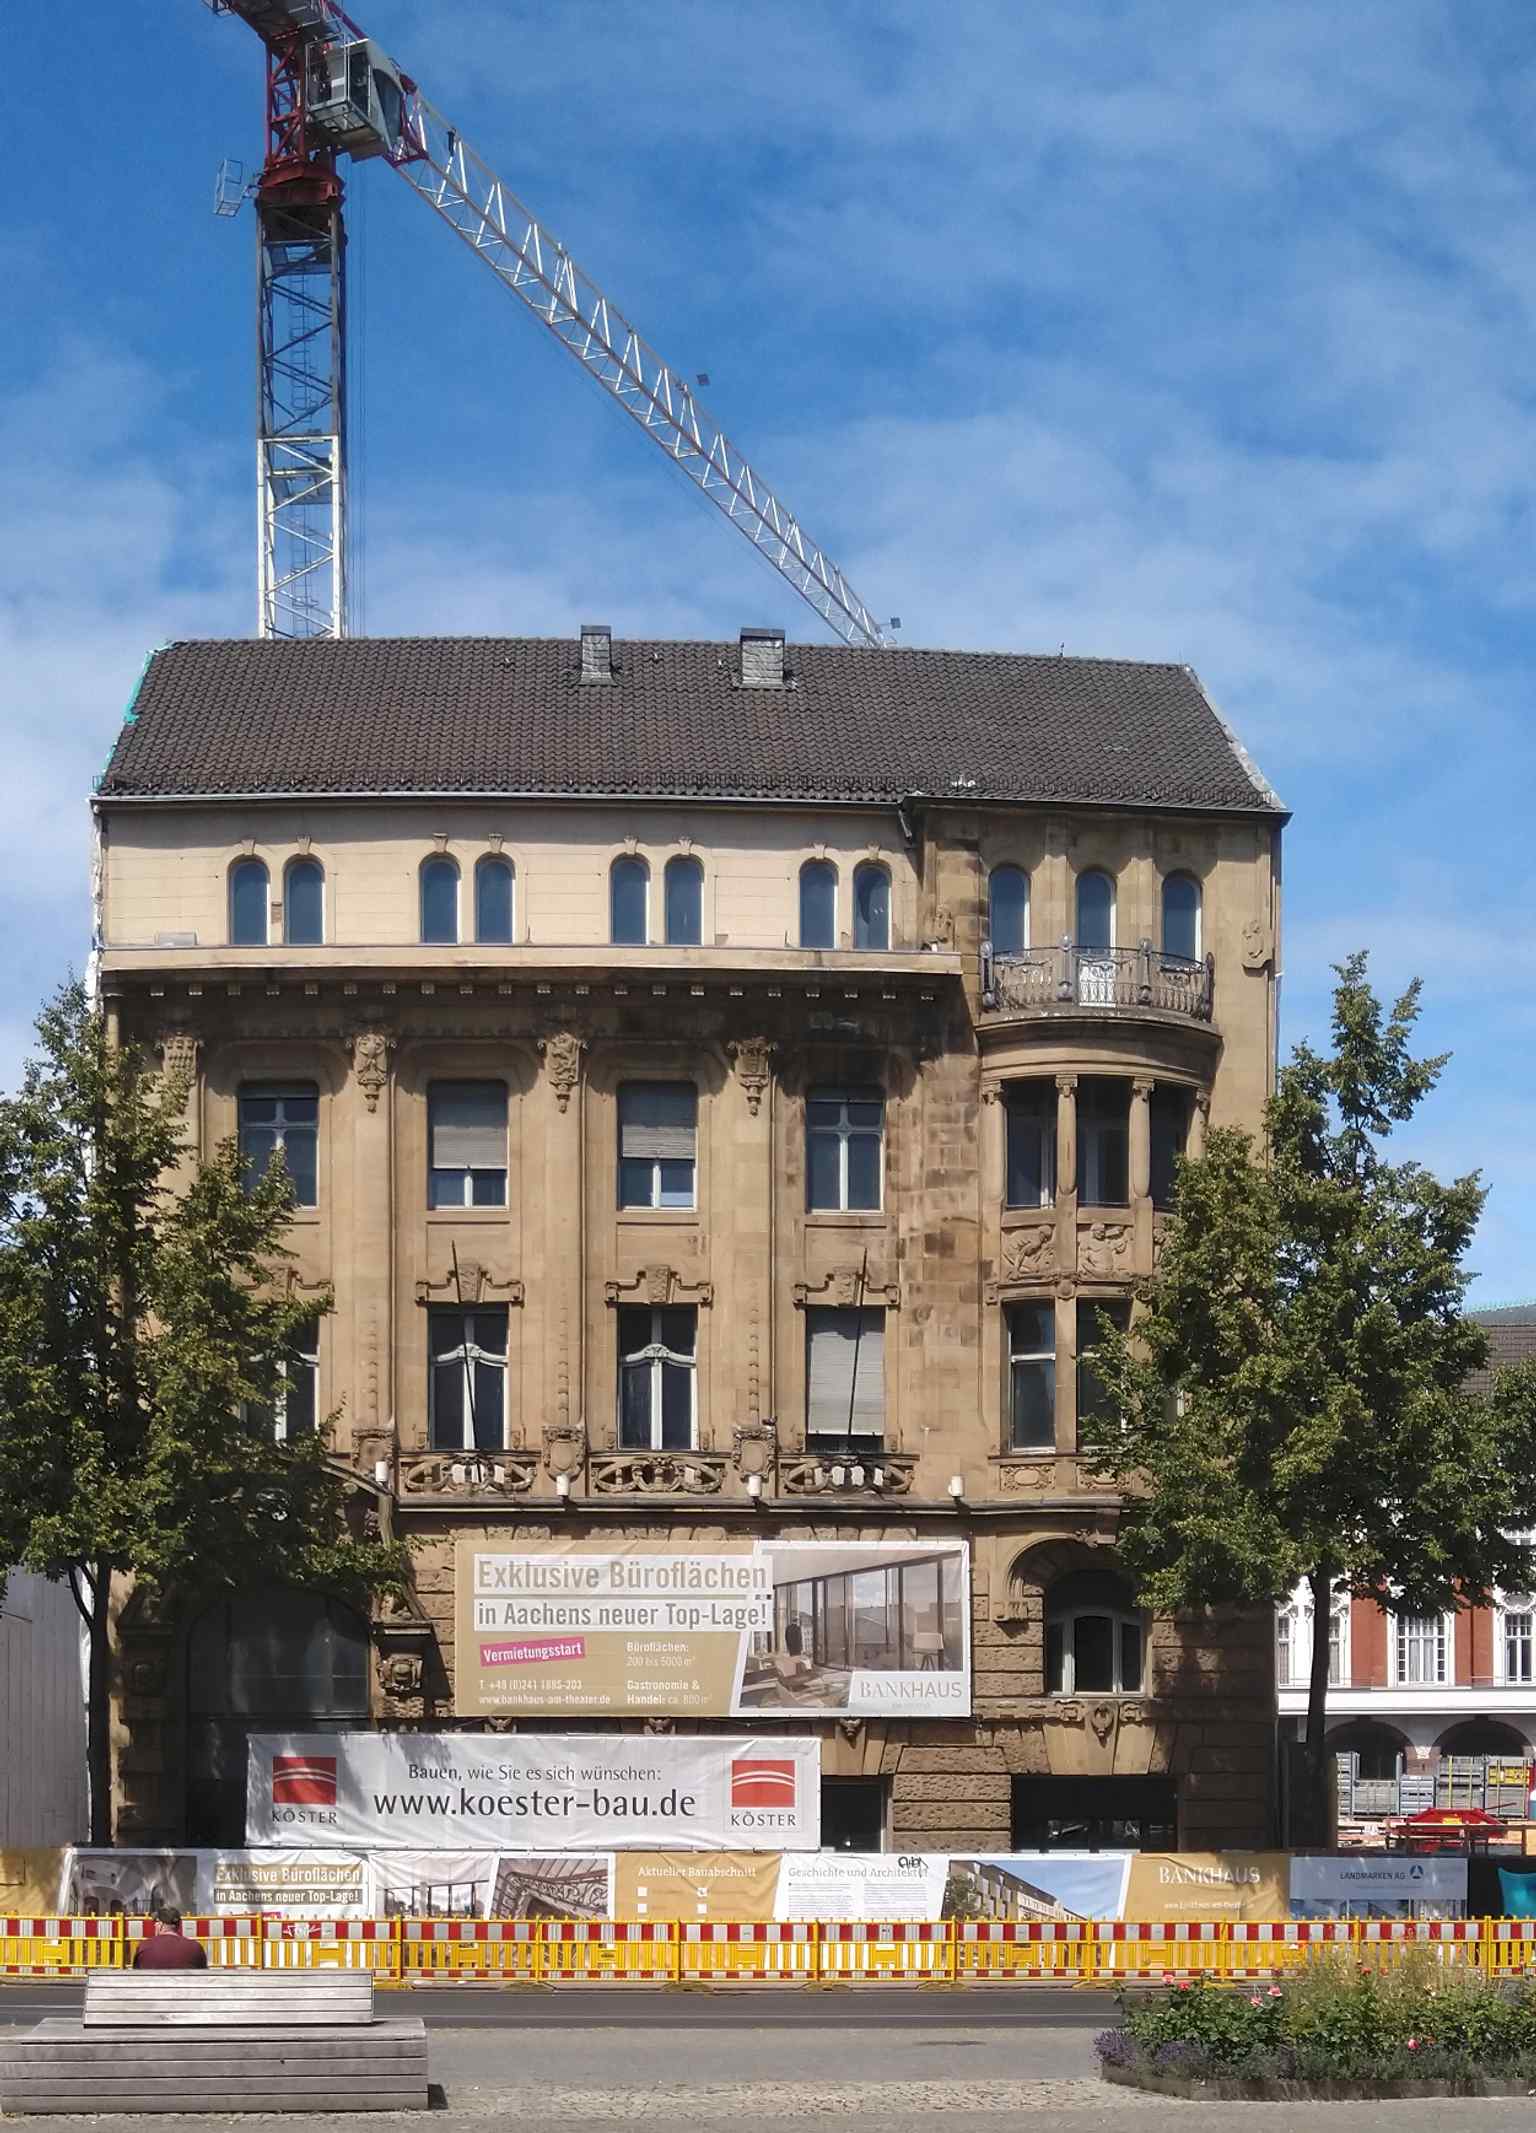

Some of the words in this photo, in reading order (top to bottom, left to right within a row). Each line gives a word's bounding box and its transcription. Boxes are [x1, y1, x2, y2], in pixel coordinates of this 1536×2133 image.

[478, 1561, 600, 1588] Exklusive
[610, 1561, 767, 1588] Büroflächen
[478, 1603, 497, 1625] in
[504, 1603, 591, 1625] Aachens
[600, 1607, 658, 1625] neuer
[665, 1603, 767, 1629] Top-Lage!
[483, 1642, 582, 1662] Vermietungsstart
[860, 1681, 962, 1698] BANKHAUS
[408, 1764, 462, 1781] Bauen,
[468, 1766, 494, 1780] wie
[499, 1765, 521, 1780] Sie
[526, 1768, 542, 1780] es
[546, 1765, 575, 1780] sich
[580, 1765, 662, 1781] wünschen:
[373, 1788, 696, 1817] www.koester-bau.de
[272, 1808, 337, 1823] KÖSTER
[731, 1811, 796, 1826] KÖSTER
[216, 1866, 277, 1882] Exklusive
[281, 1866, 360, 1882] Büroflächen
[788, 1867, 846, 1878] Geschichte
[847, 1867, 868, 1878] und
[869, 1867, 930, 1878] Architektu
[1159, 1866, 1261, 1884] BANKHAUS
[216, 1890, 226, 1901] in
[229, 1890, 272, 1901] Aachens
[276, 1892, 306, 1901] neuer
[308, 1890, 359, 1903] Top-Lage!
